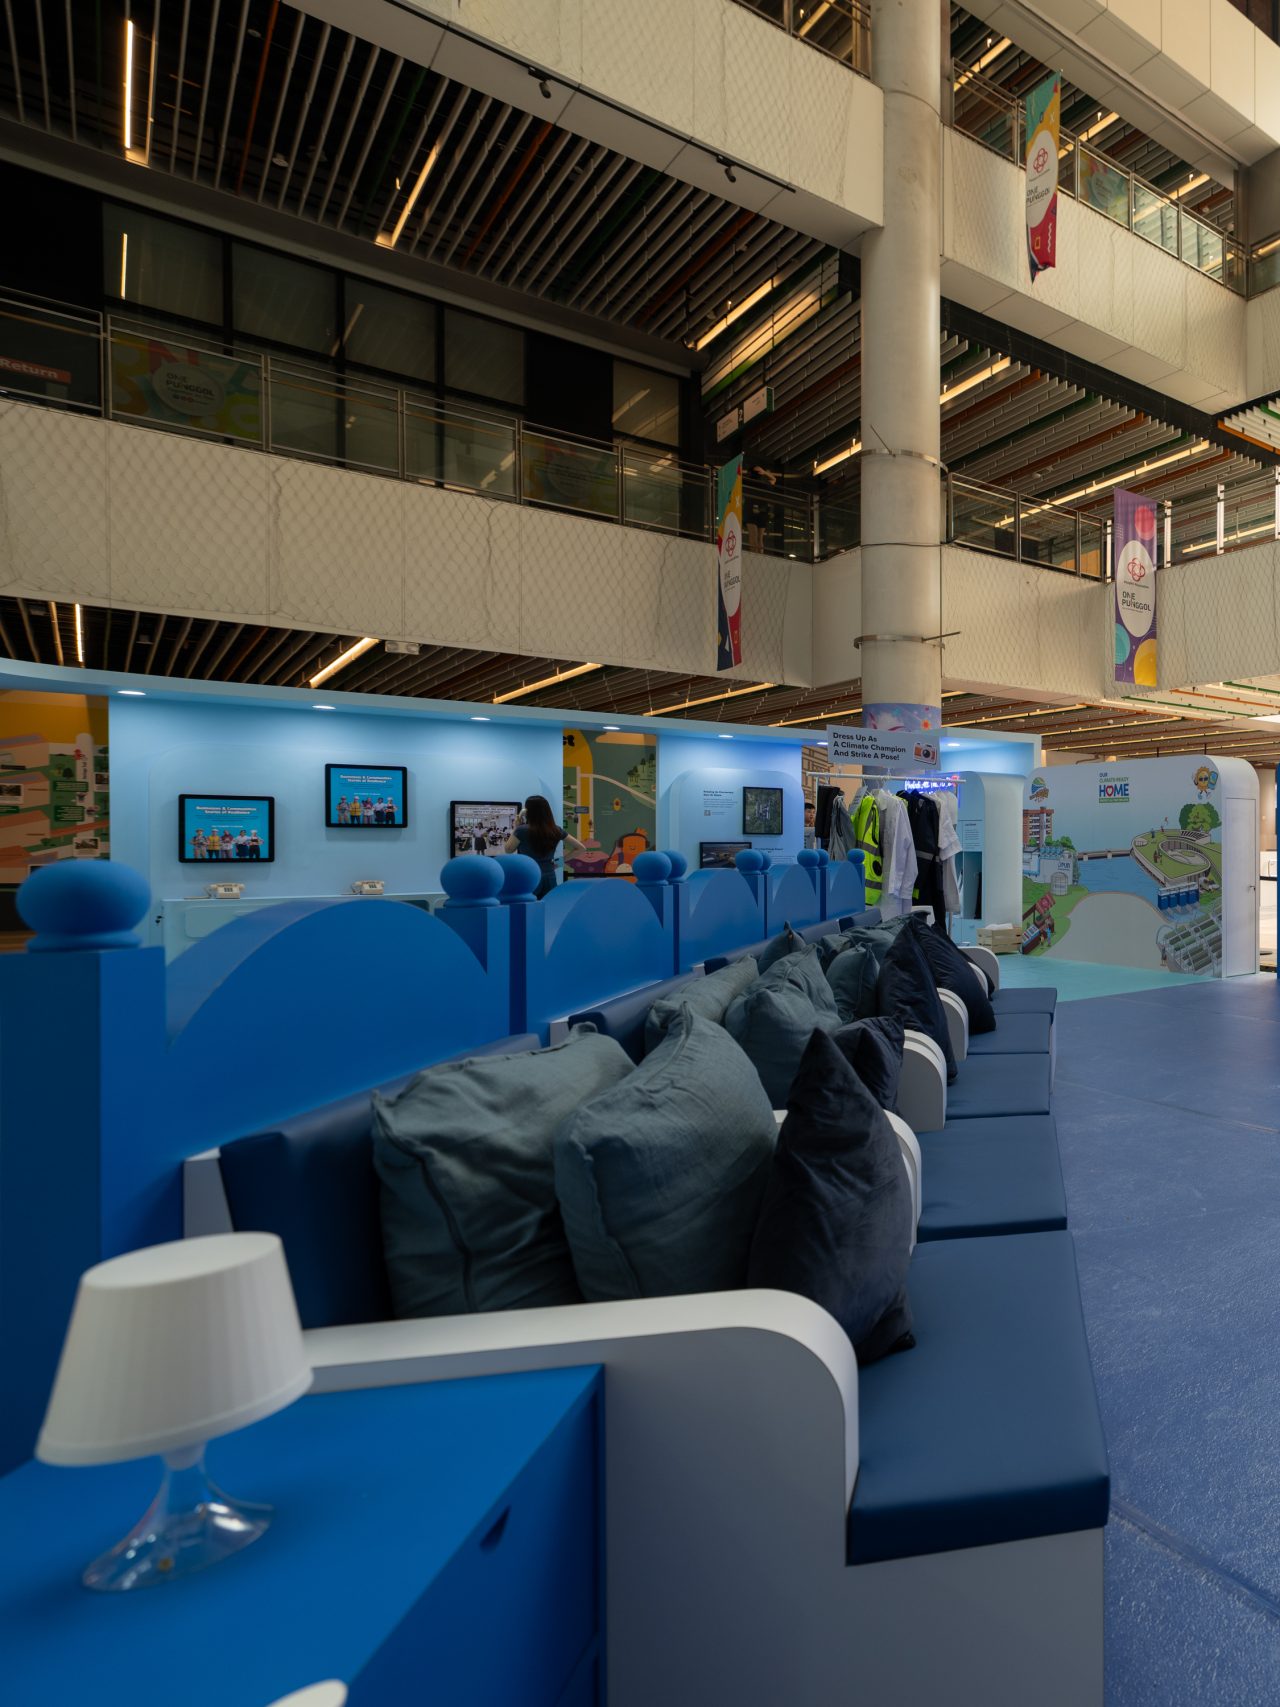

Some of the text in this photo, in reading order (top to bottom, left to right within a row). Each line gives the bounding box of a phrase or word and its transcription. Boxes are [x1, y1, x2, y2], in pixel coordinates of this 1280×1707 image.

[165, 379, 215, 397] PUNGGOL
[1122, 591, 1136, 600] ONE
[1122, 599, 1151, 611] PUNGGOL
[871, 745, 906, 753] Champion
[1099, 783, 1129, 797] HOME
